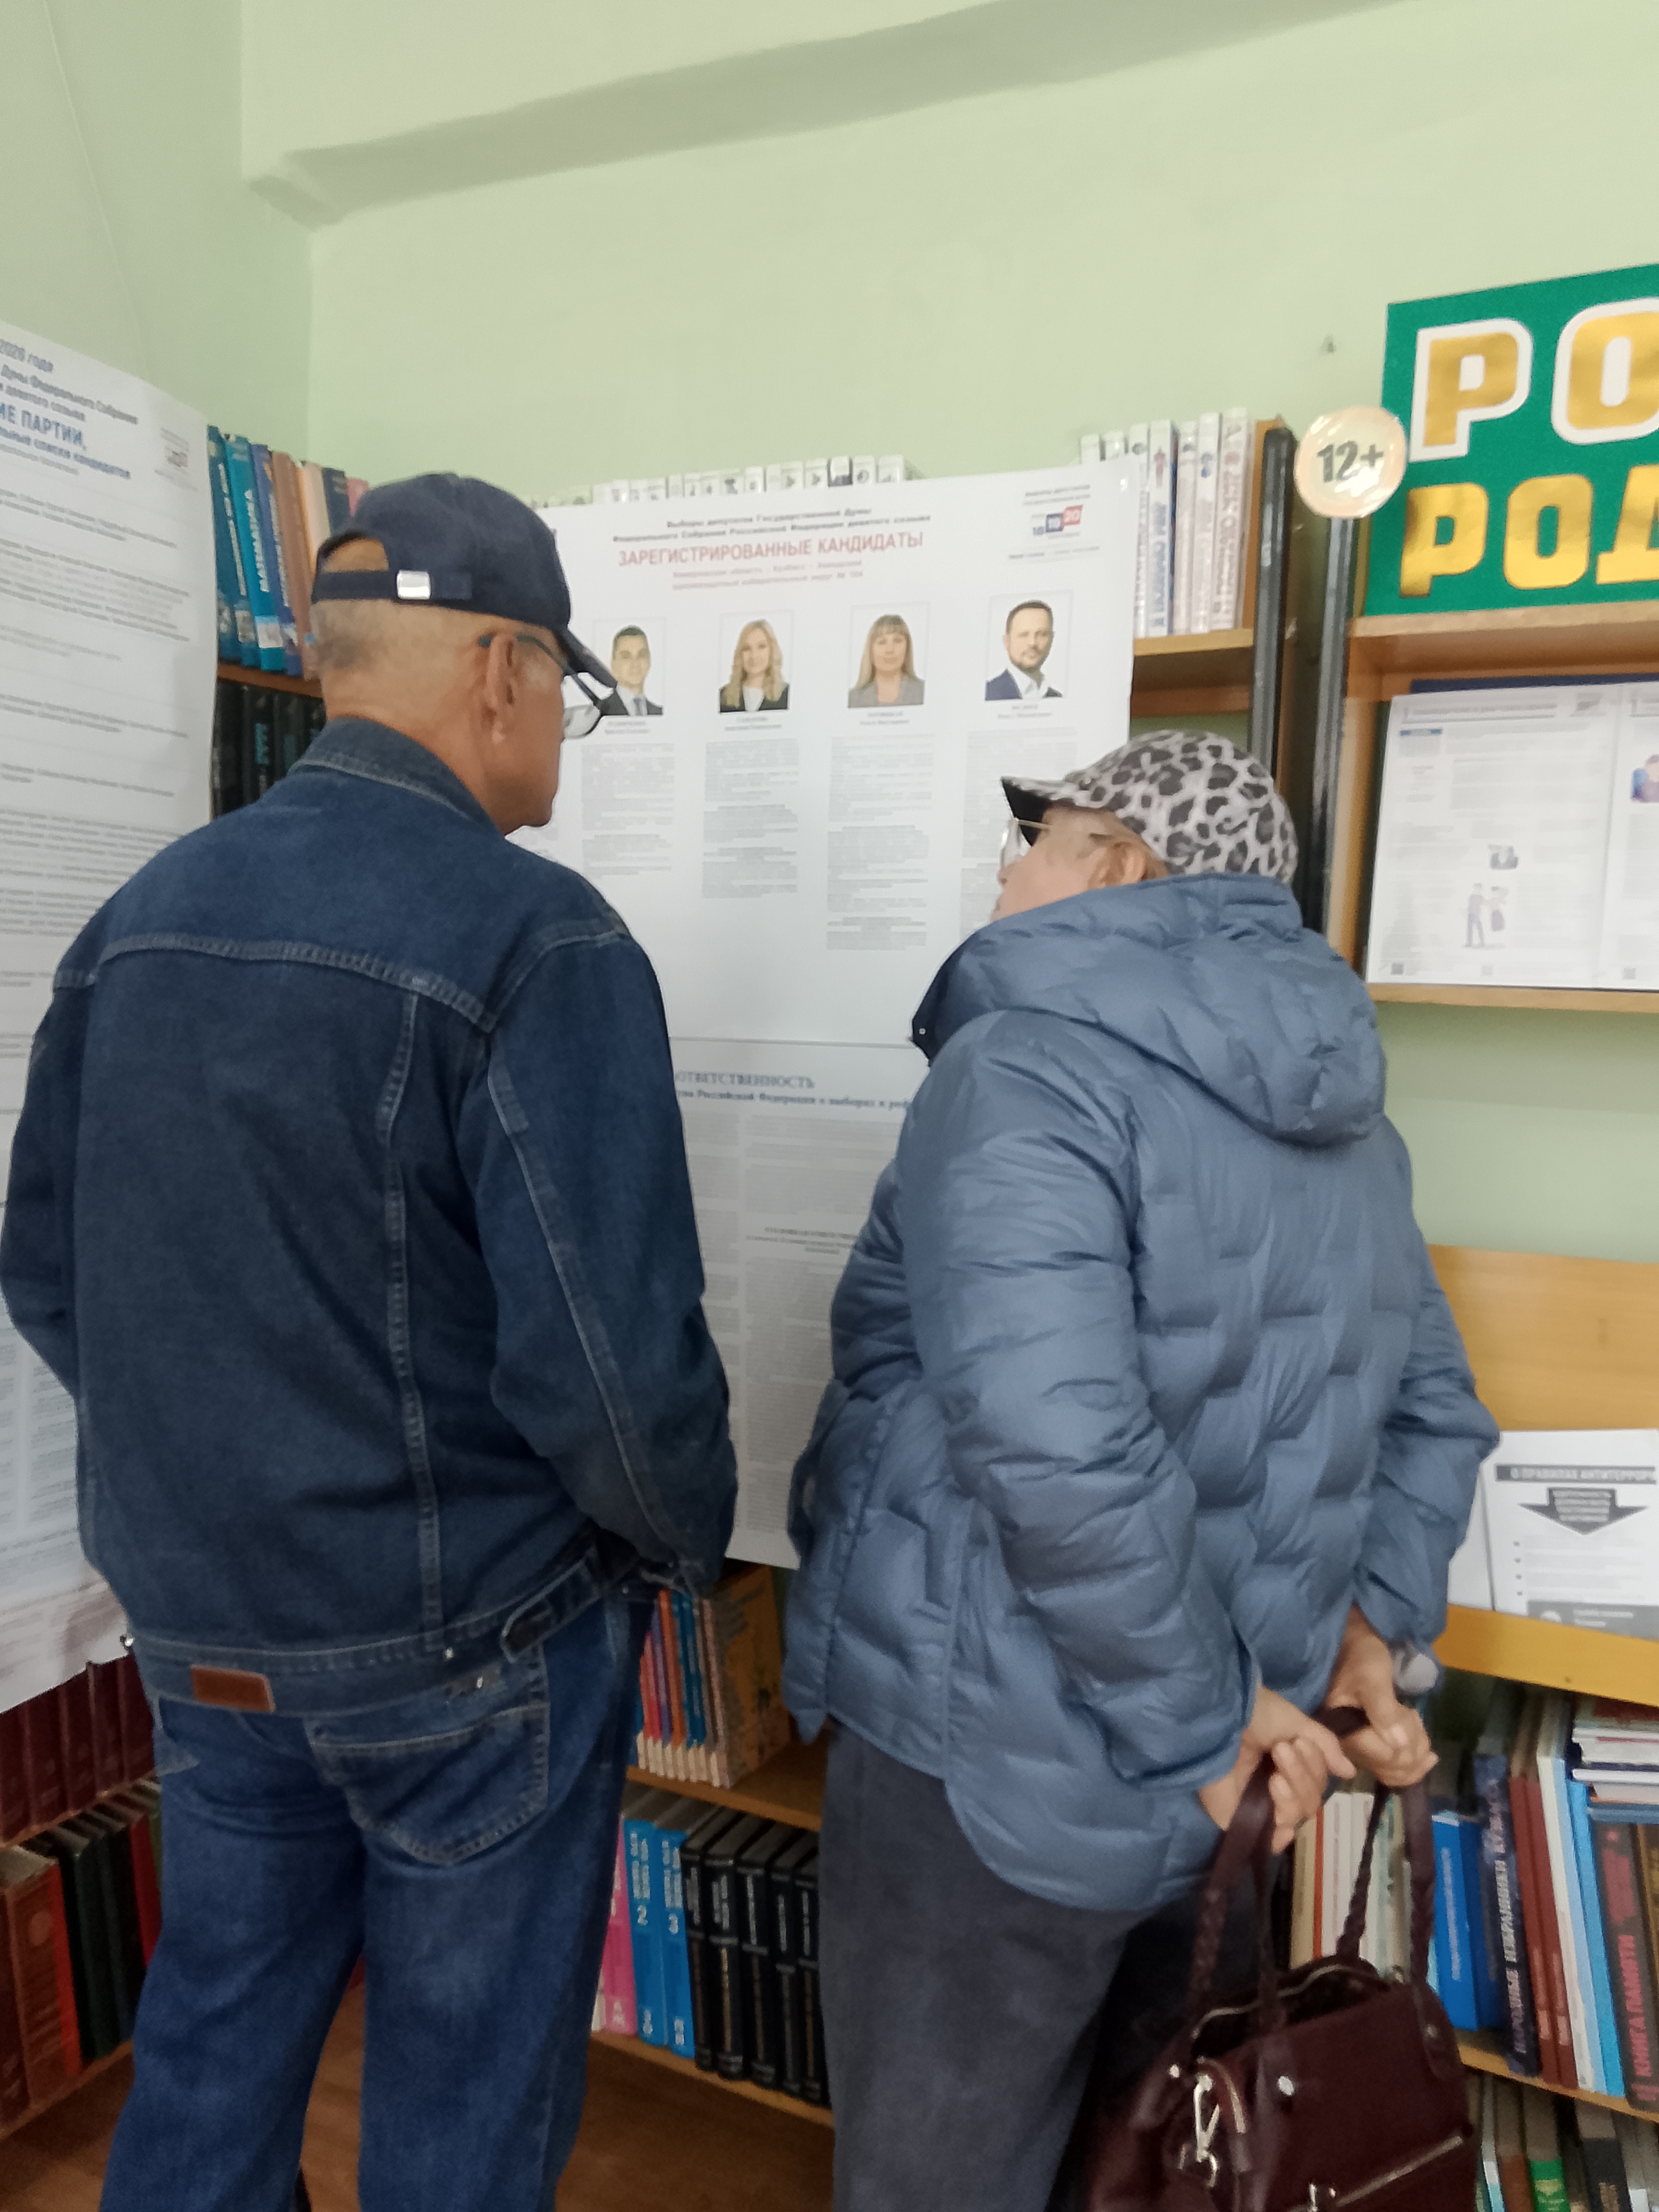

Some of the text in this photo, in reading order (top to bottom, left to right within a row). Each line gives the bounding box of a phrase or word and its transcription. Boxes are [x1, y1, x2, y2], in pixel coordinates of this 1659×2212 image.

[1317, 440, 1384, 483] 12+
[618, 532, 924, 567] ЗАРЕГИСТРИРОВАННЫЕ КАНДИДАТЫ
